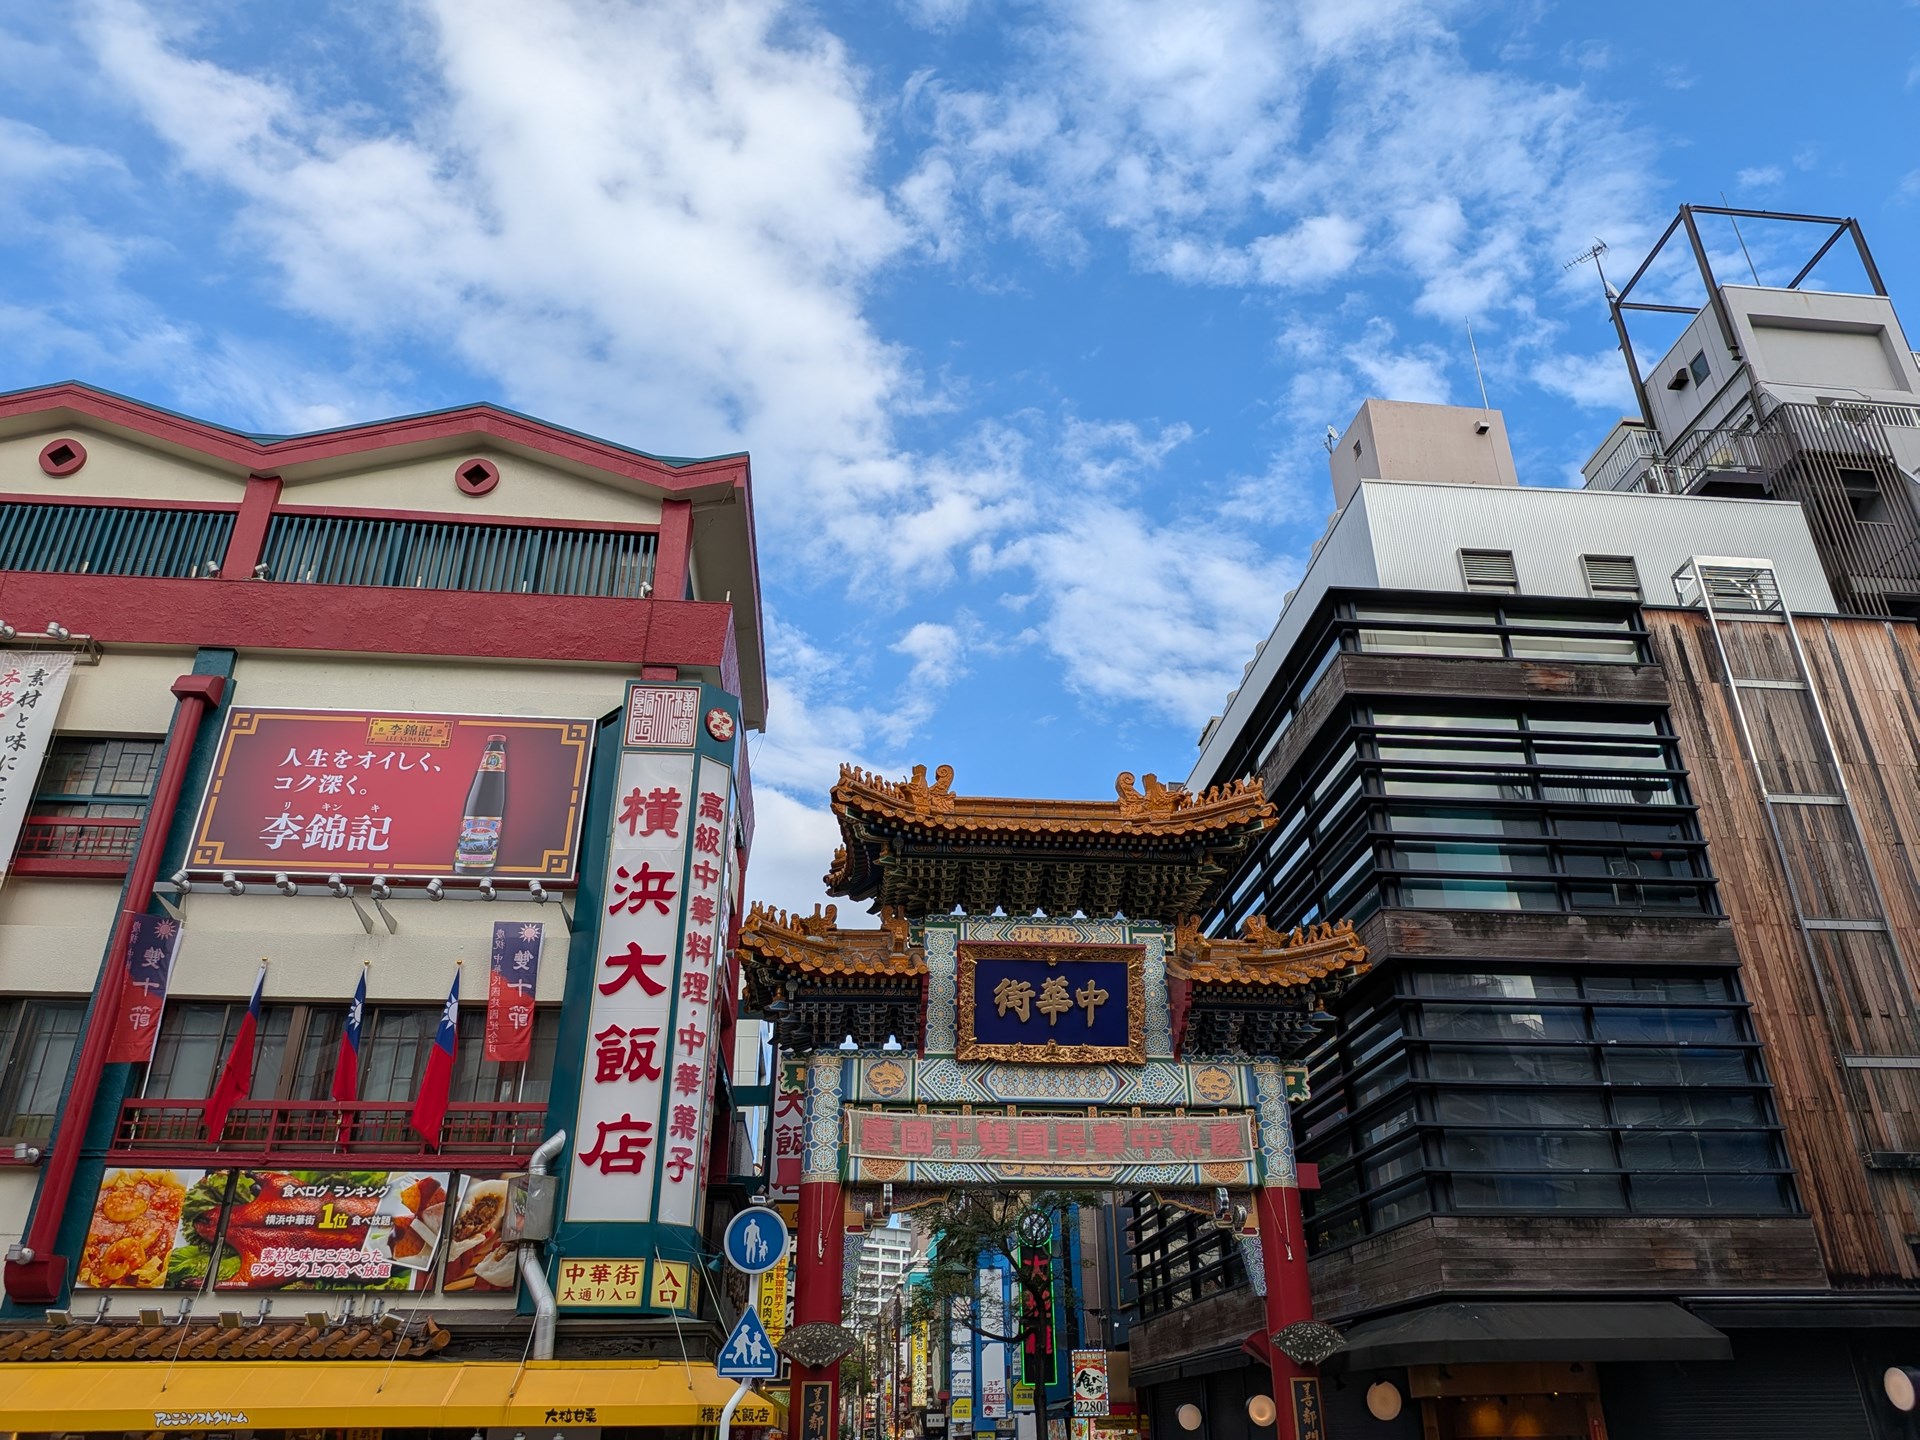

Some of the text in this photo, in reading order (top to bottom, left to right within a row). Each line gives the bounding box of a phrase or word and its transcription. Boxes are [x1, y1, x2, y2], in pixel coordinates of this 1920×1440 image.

[0, 669, 21, 720] 本格
[388, 723, 433, 737] 李錦記
[278, 747, 444, 773] 人生をオイしく、
[272, 773, 370, 796] コク深く。
[321, 801, 342, 812] キン
[258, 812, 394, 853] 李錦記
[579, 787, 682, 1176] 横浜大飯店
[666, 791, 725, 1185] 高級中華料理・中華菓子
[282, 1184, 390, 1198] 食べログ ランキング
[265, 1202, 391, 1229] 横浜中華街 1位 食べ放題
[260, 1247, 383, 1263] 素材と味にこだわった
[250, 1263, 392, 1279] ワンランク上の食べ放題
[565, 1262, 640, 1286] 中華街
[562, 1287, 638, 1302] 大通り入口
[658, 1265, 682, 1304] 入口
[544, 1407, 597, 1425] 大粒甘栗
[808, 1386, 825, 1440] 善鄰
[1077, 1400, 1103, 1413] 2280
